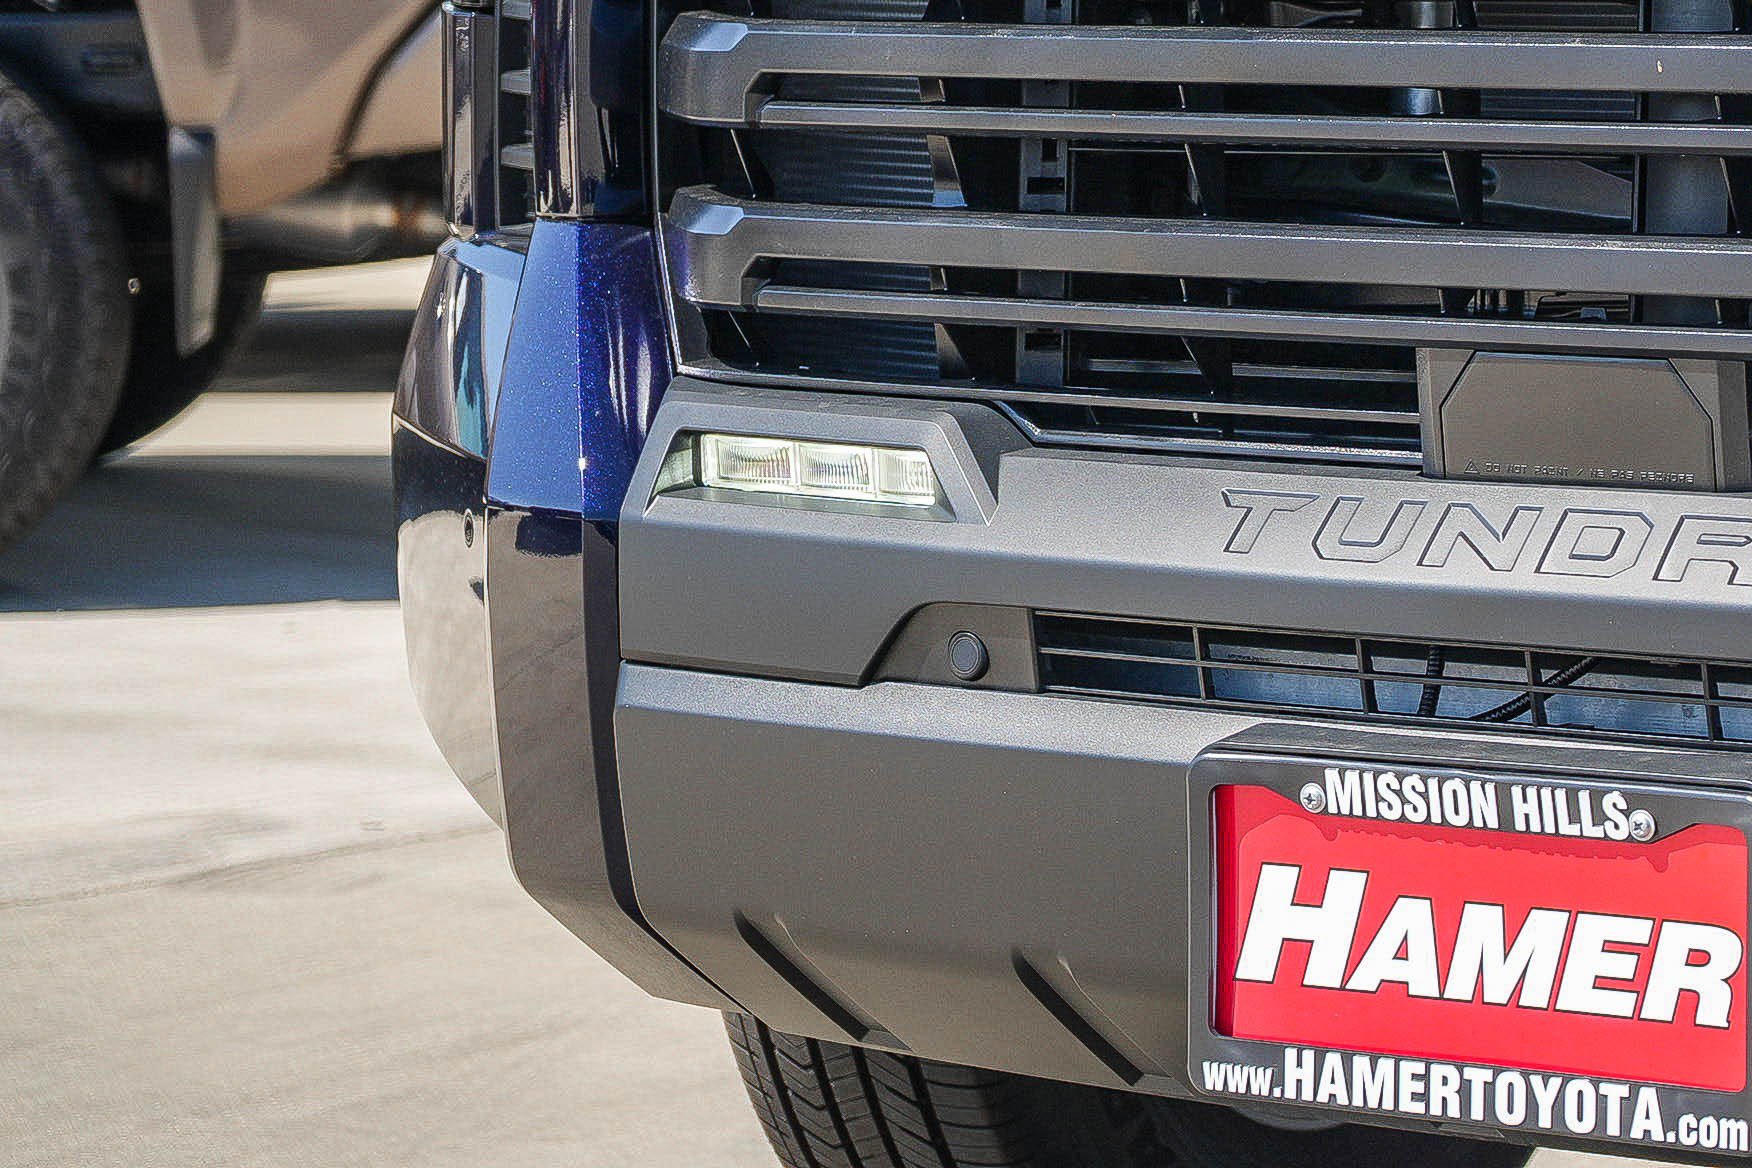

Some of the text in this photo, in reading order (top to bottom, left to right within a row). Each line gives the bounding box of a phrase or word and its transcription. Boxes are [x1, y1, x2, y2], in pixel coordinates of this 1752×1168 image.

[1325, 768, 1630, 841] MISSION HILLS
[1235, 863, 1743, 1029] HAMER
[1202, 1048, 1750, 1152] www.HAMERTOYOTA.com
